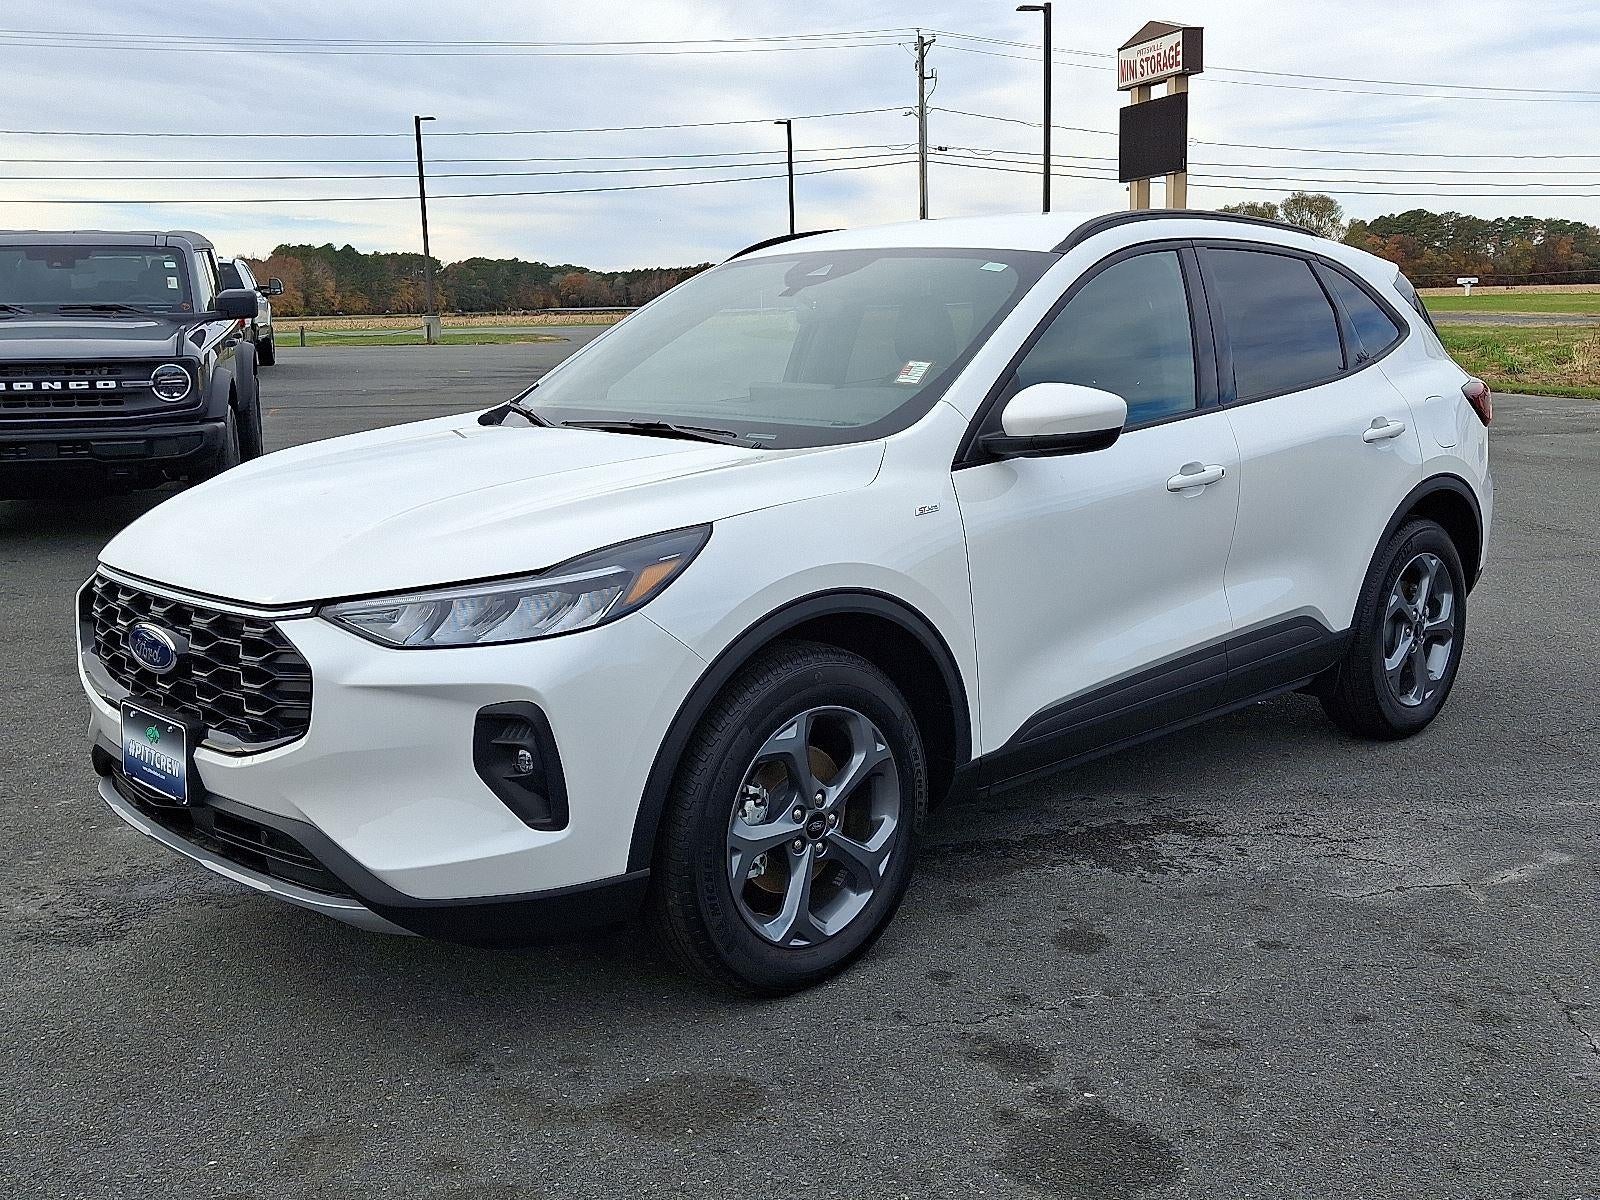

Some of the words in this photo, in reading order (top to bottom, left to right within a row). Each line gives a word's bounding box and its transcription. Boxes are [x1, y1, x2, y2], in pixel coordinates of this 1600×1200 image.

[1120, 58, 1137, 83] MINI
[1139, 40, 1181, 77] STORAGE
[0, 380, 117, 391] ONCO
[135, 639, 161, 663] Ford
[129, 739, 180, 778] #PITTCREW
